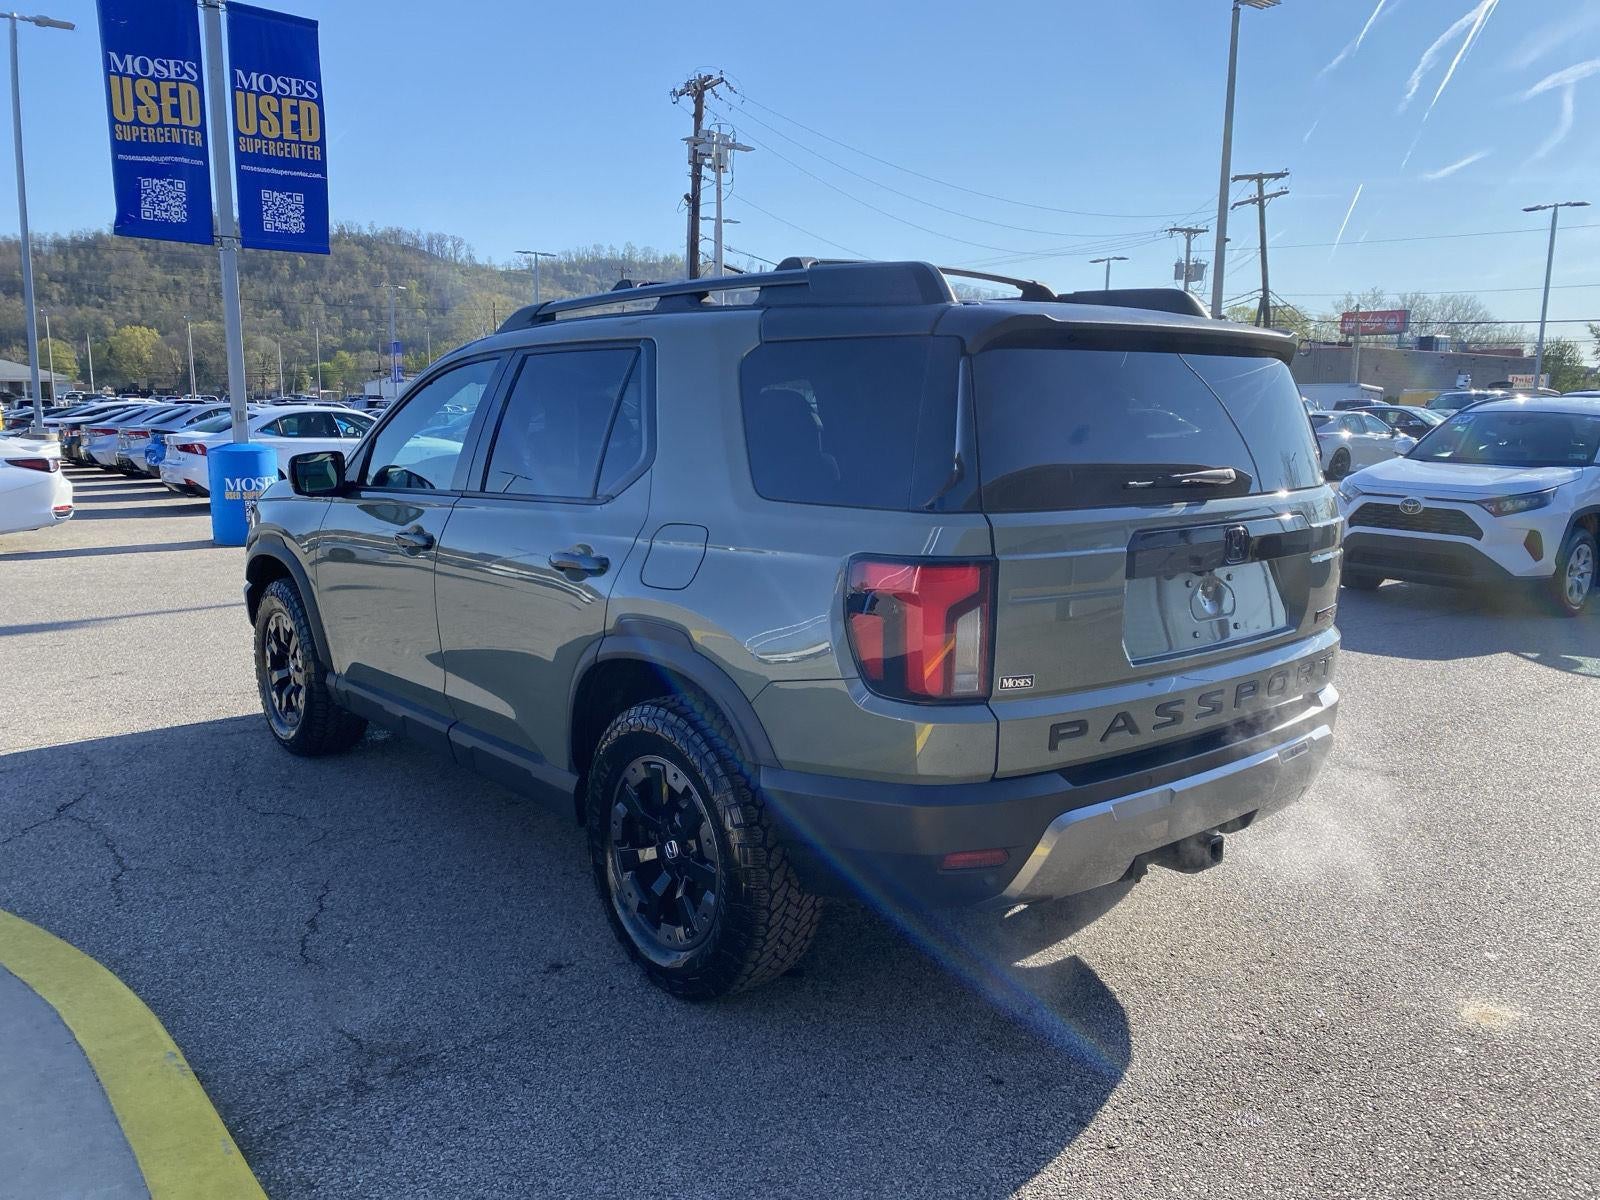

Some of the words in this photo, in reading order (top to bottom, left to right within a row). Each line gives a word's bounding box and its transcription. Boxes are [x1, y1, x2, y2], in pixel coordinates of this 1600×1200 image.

[108, 51, 198, 82] MOSES
[234, 68, 318, 100] MOSES
[109, 75, 201, 127] USED
[235, 90, 320, 142] USED
[114, 124, 203, 147] SUPERCENTER
[239, 136, 321, 161] SUPERCENTER
[117, 154, 204, 166] mosesusedsupercenter.com
[241, 164, 321, 178] mosesusedsupercenter.com
[1002, 678, 1032, 688] MOSES
[1048, 652, 1334, 751] PASSPORT
